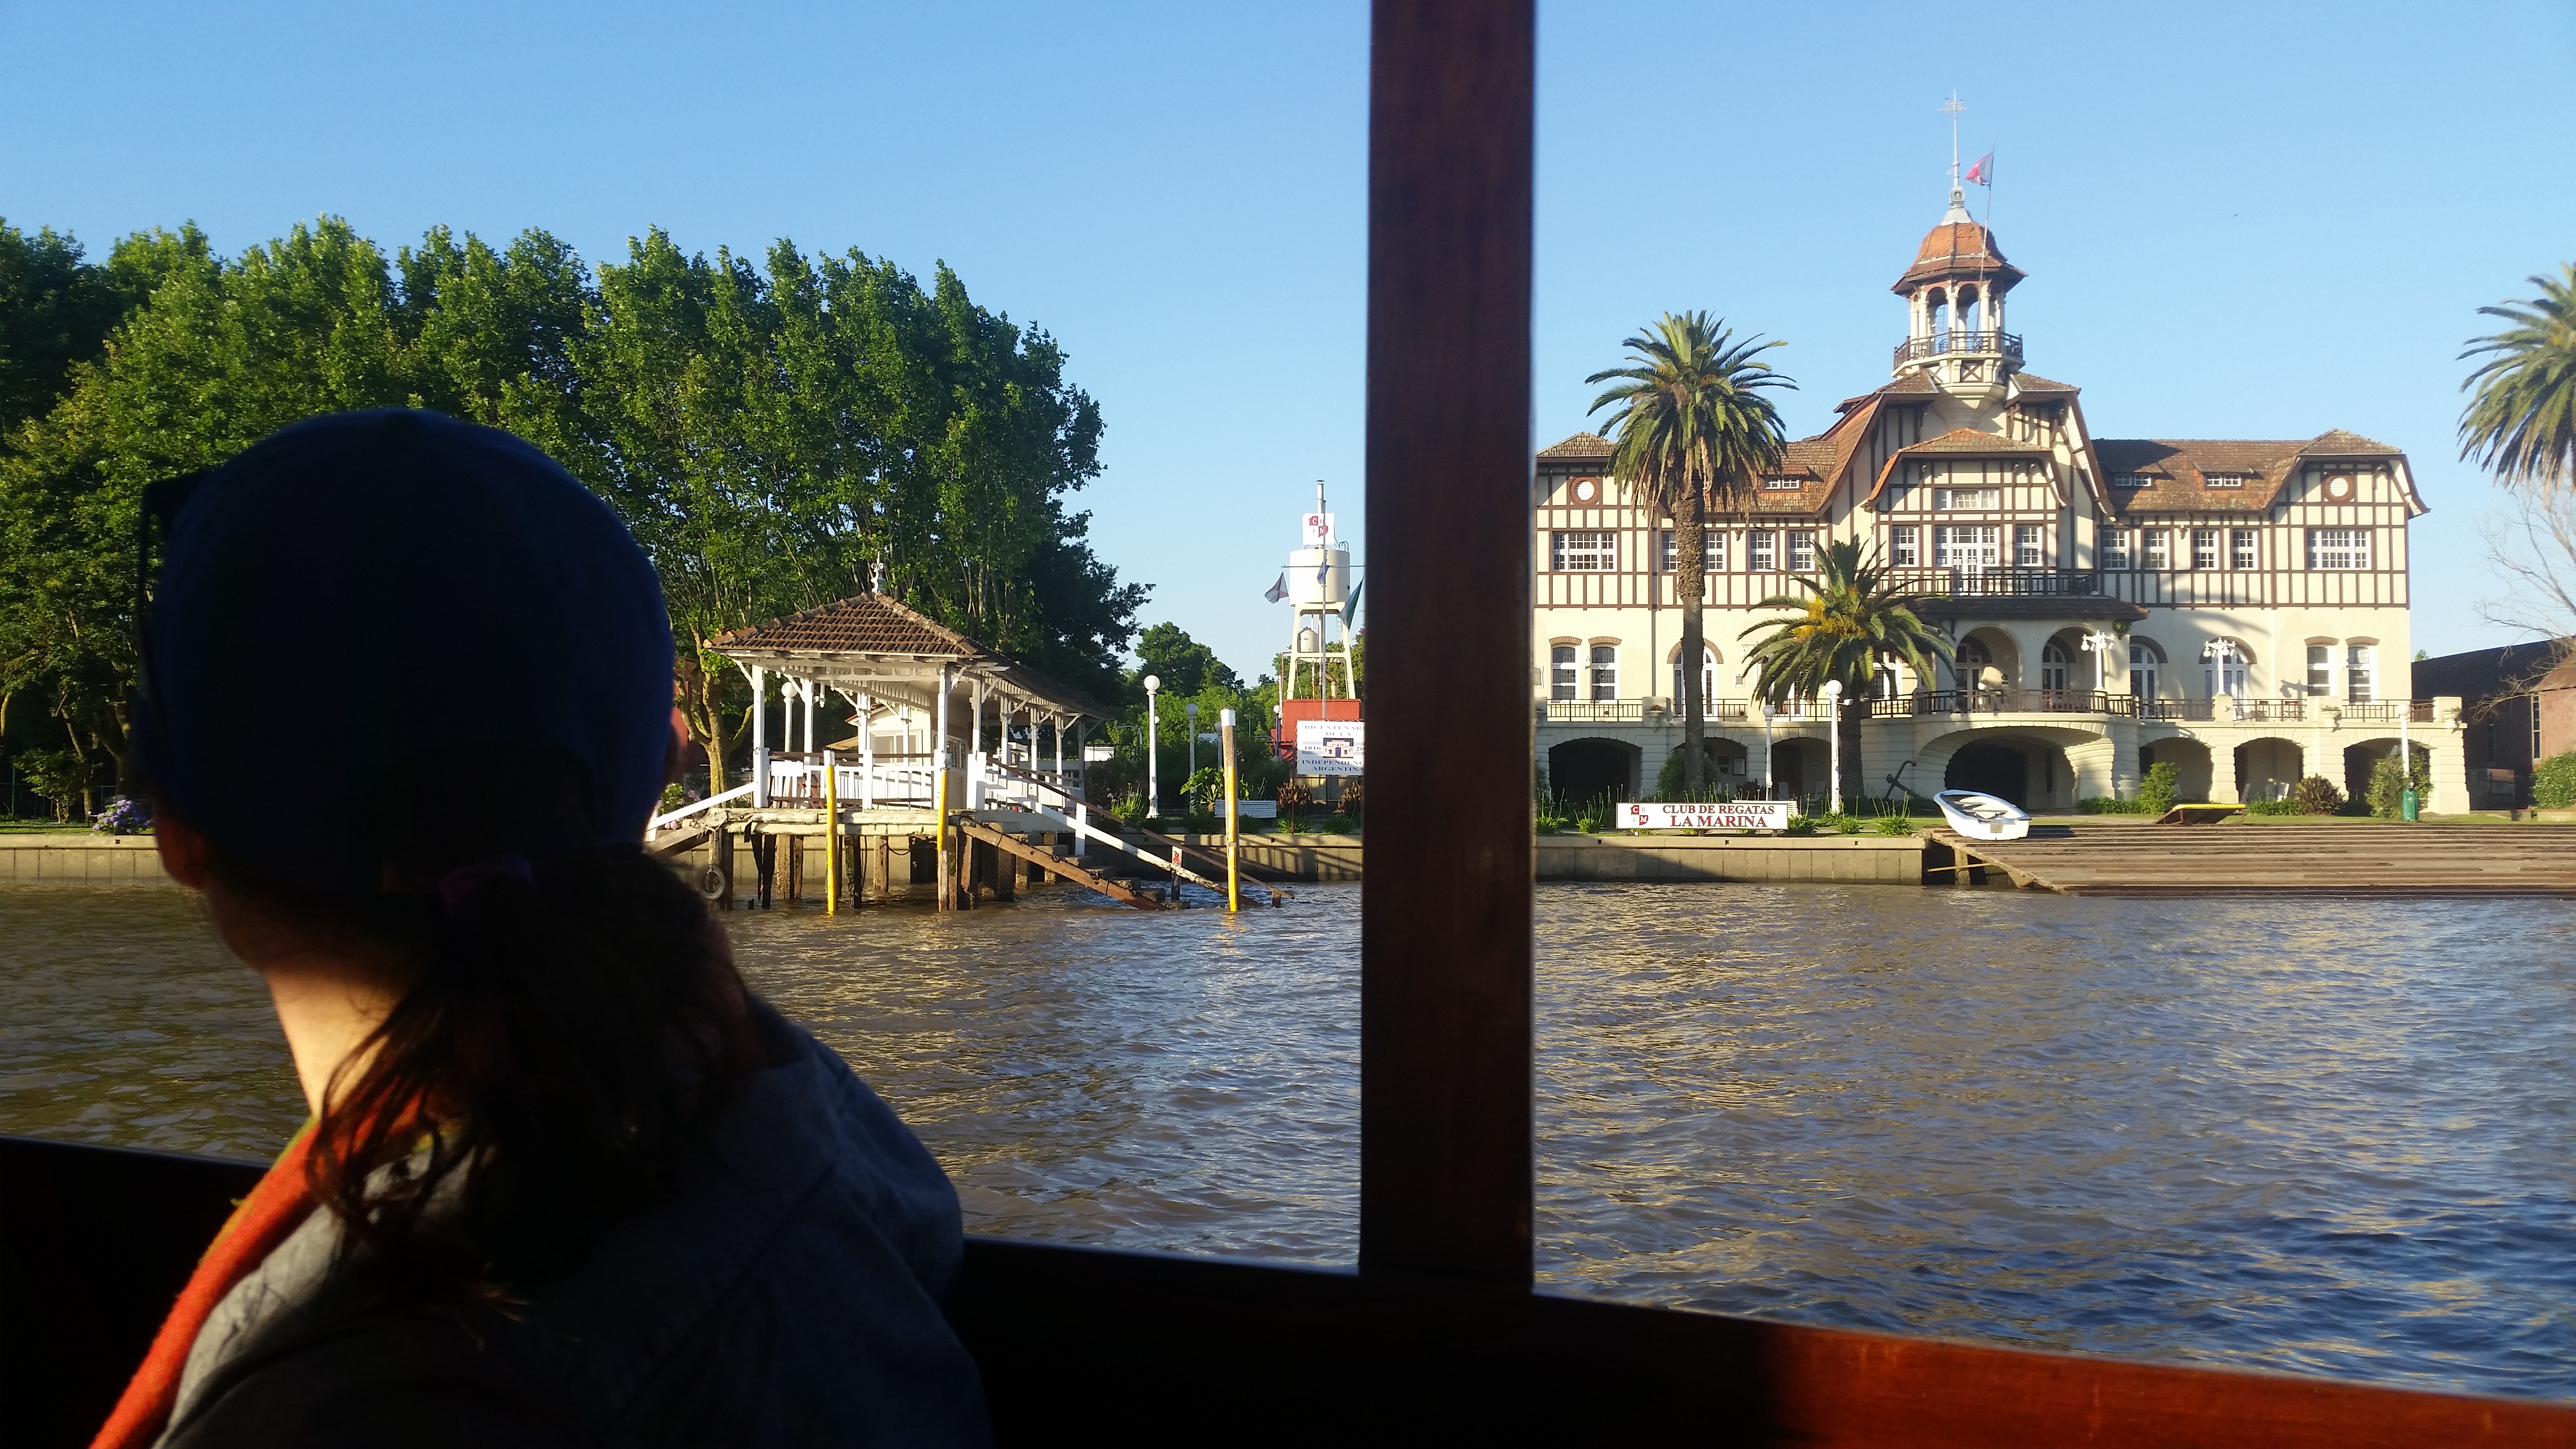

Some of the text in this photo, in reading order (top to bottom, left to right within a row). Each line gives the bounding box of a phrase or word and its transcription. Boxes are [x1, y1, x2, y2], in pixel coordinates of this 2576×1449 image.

[1662, 805, 1775, 815] CLUB DE REGATAS
[1670, 815, 1768, 827] LA MARINA
